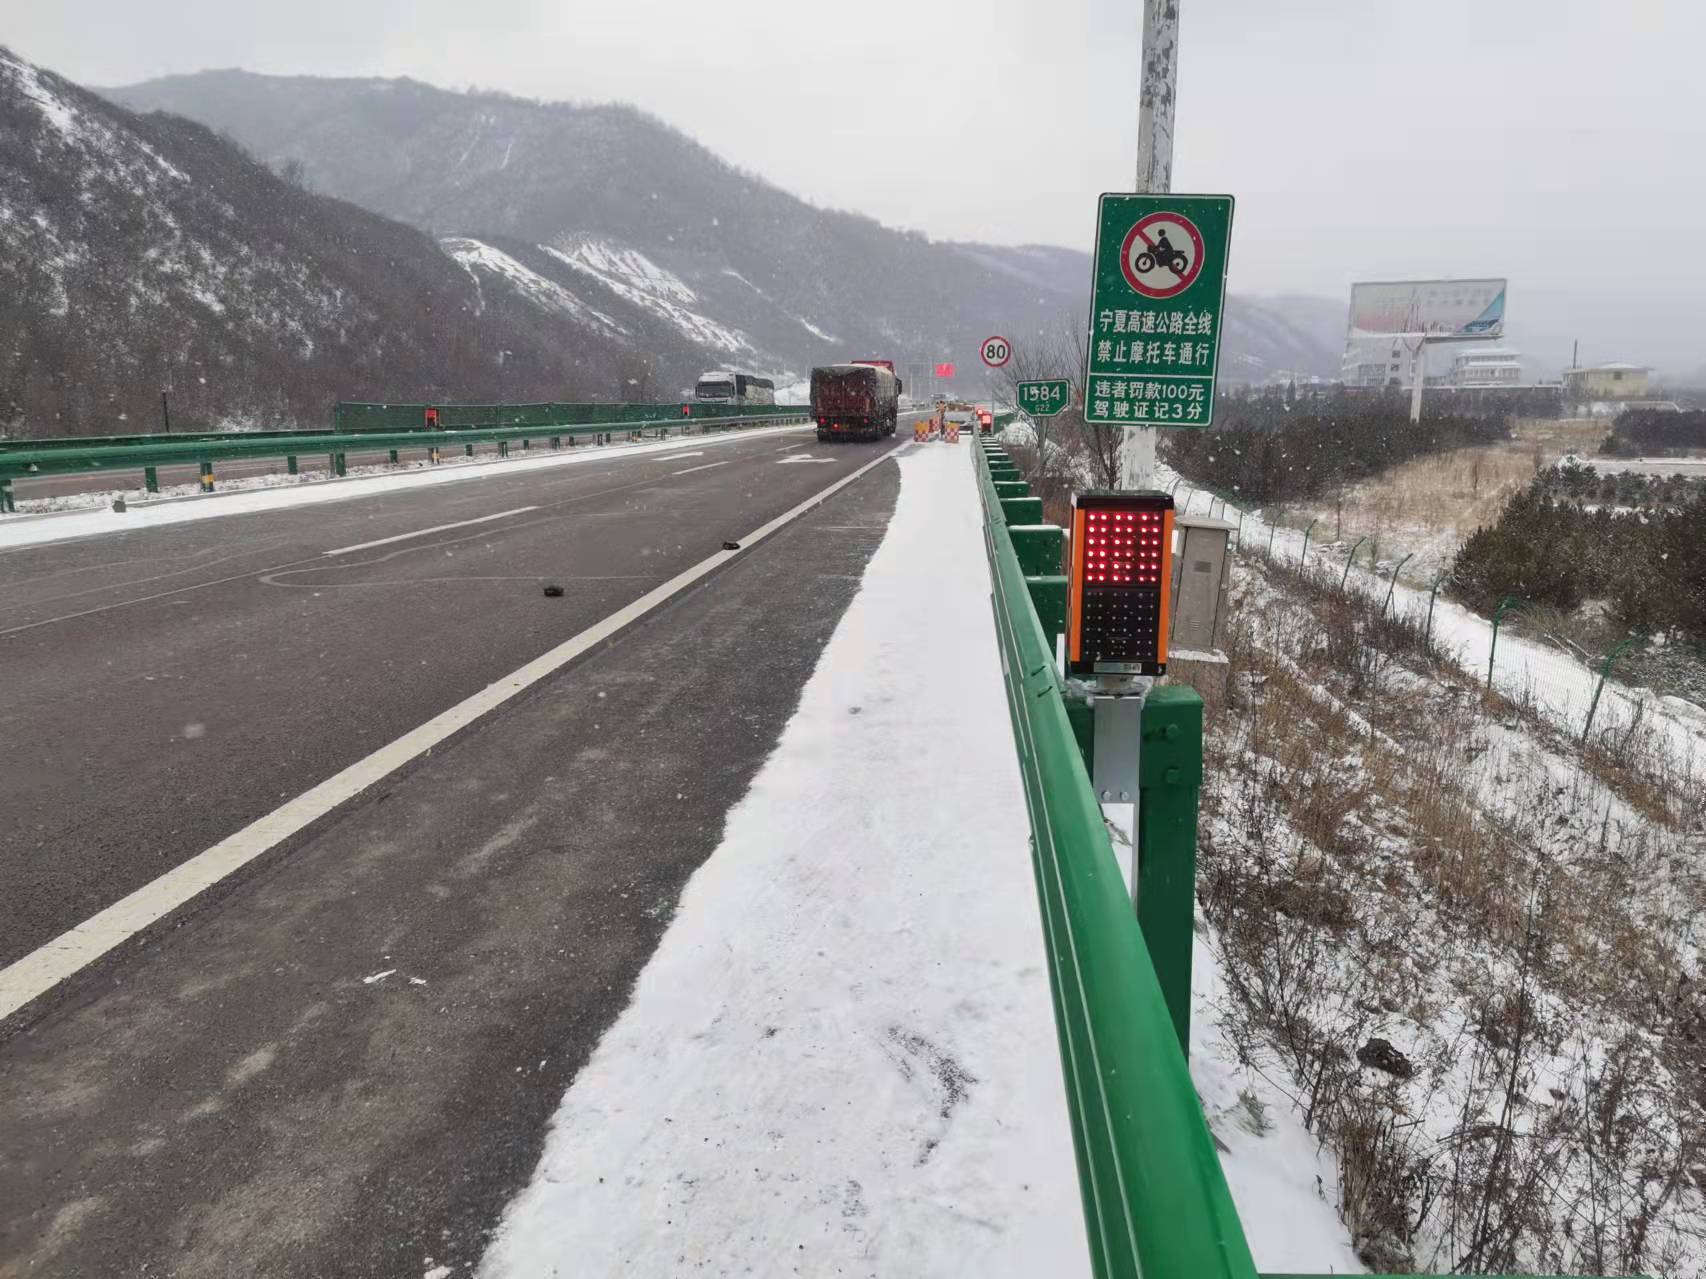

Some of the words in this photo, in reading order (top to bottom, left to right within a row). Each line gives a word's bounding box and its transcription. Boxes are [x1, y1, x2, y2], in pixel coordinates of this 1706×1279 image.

[1099, 309, 1212, 335] 宁夏高速公路全线
[987, 345, 1005, 359] 80
[1097, 340, 1210, 366] 禁止摩托车通行
[1023, 386, 1060, 401] 1584
[1094, 380, 1205, 400] 违者罚款100元
[1093, 401, 1203, 420] 驾驶证记3分
